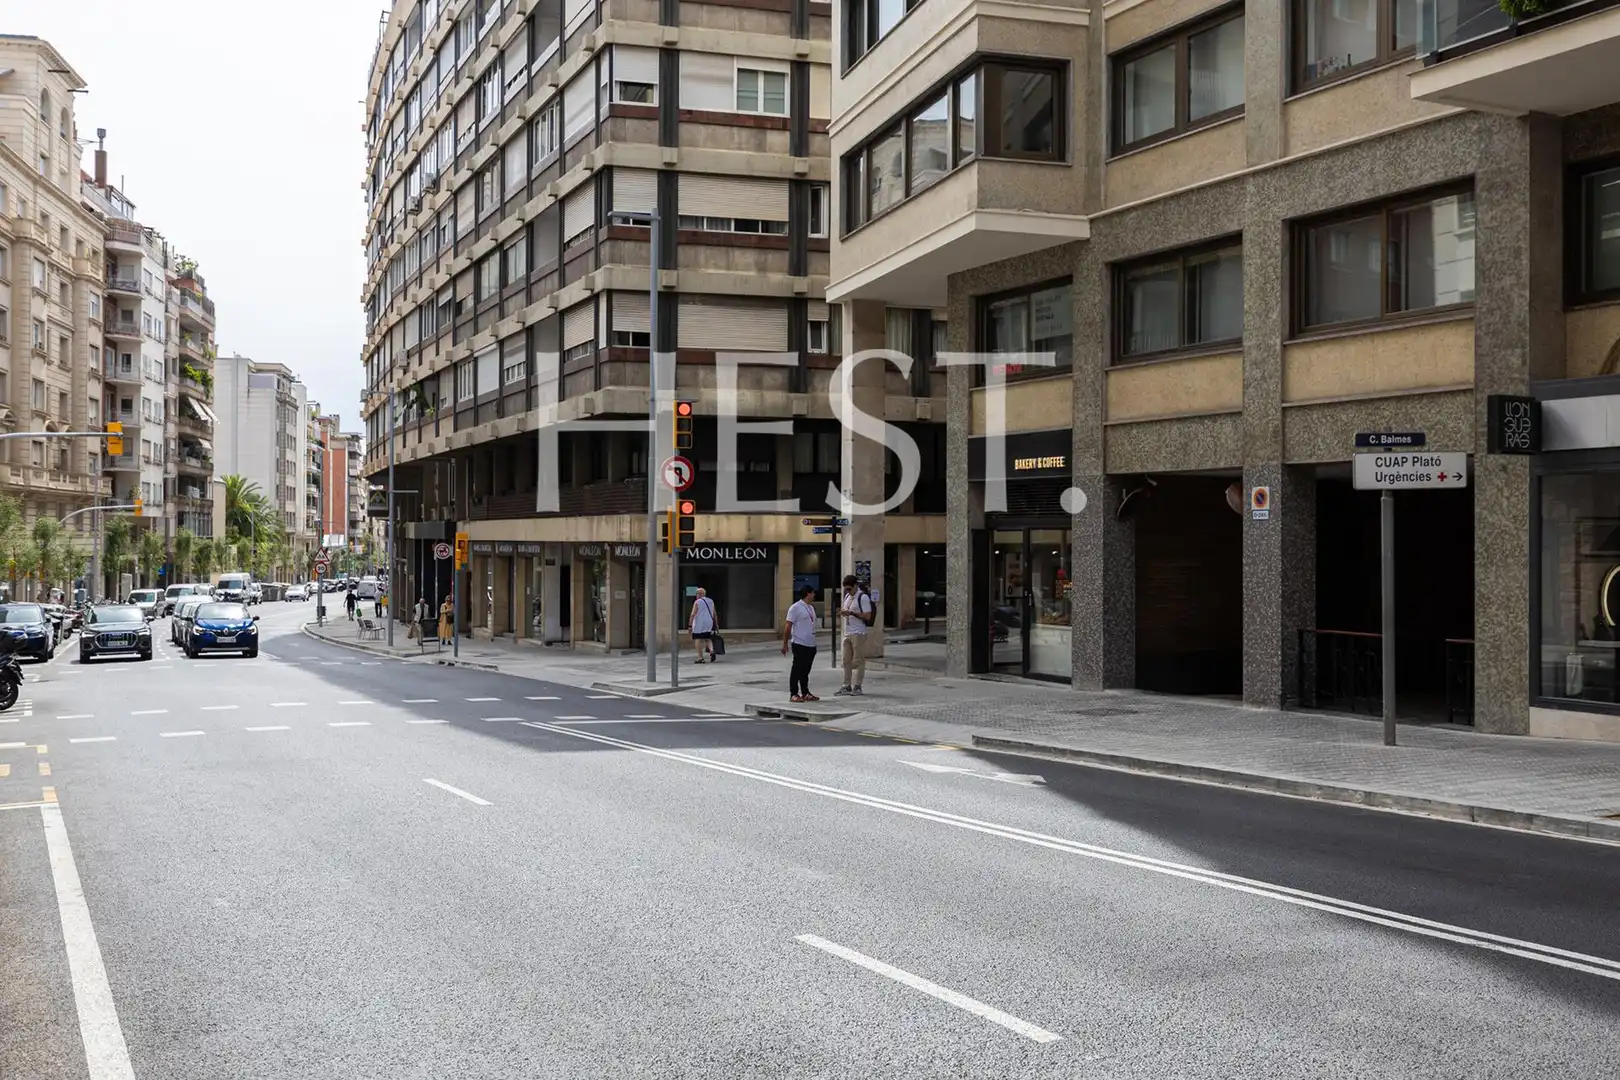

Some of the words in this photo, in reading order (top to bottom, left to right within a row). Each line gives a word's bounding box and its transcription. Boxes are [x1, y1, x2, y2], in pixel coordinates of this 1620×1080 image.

[1369, 435, 1379, 444] C.
[1381, 435, 1412, 444] Balmes
[1015, 458, 1037, 470] BAKERY
[1037, 457, 1043, 469] &
[1043, 456, 1066, 468] COFFEE
[1375, 456, 1409, 468] CUAP
[1412, 455, 1442, 467] Plató
[1375, 470, 1432, 485] Urgències
[686, 545, 767, 560] MONLEÓN
